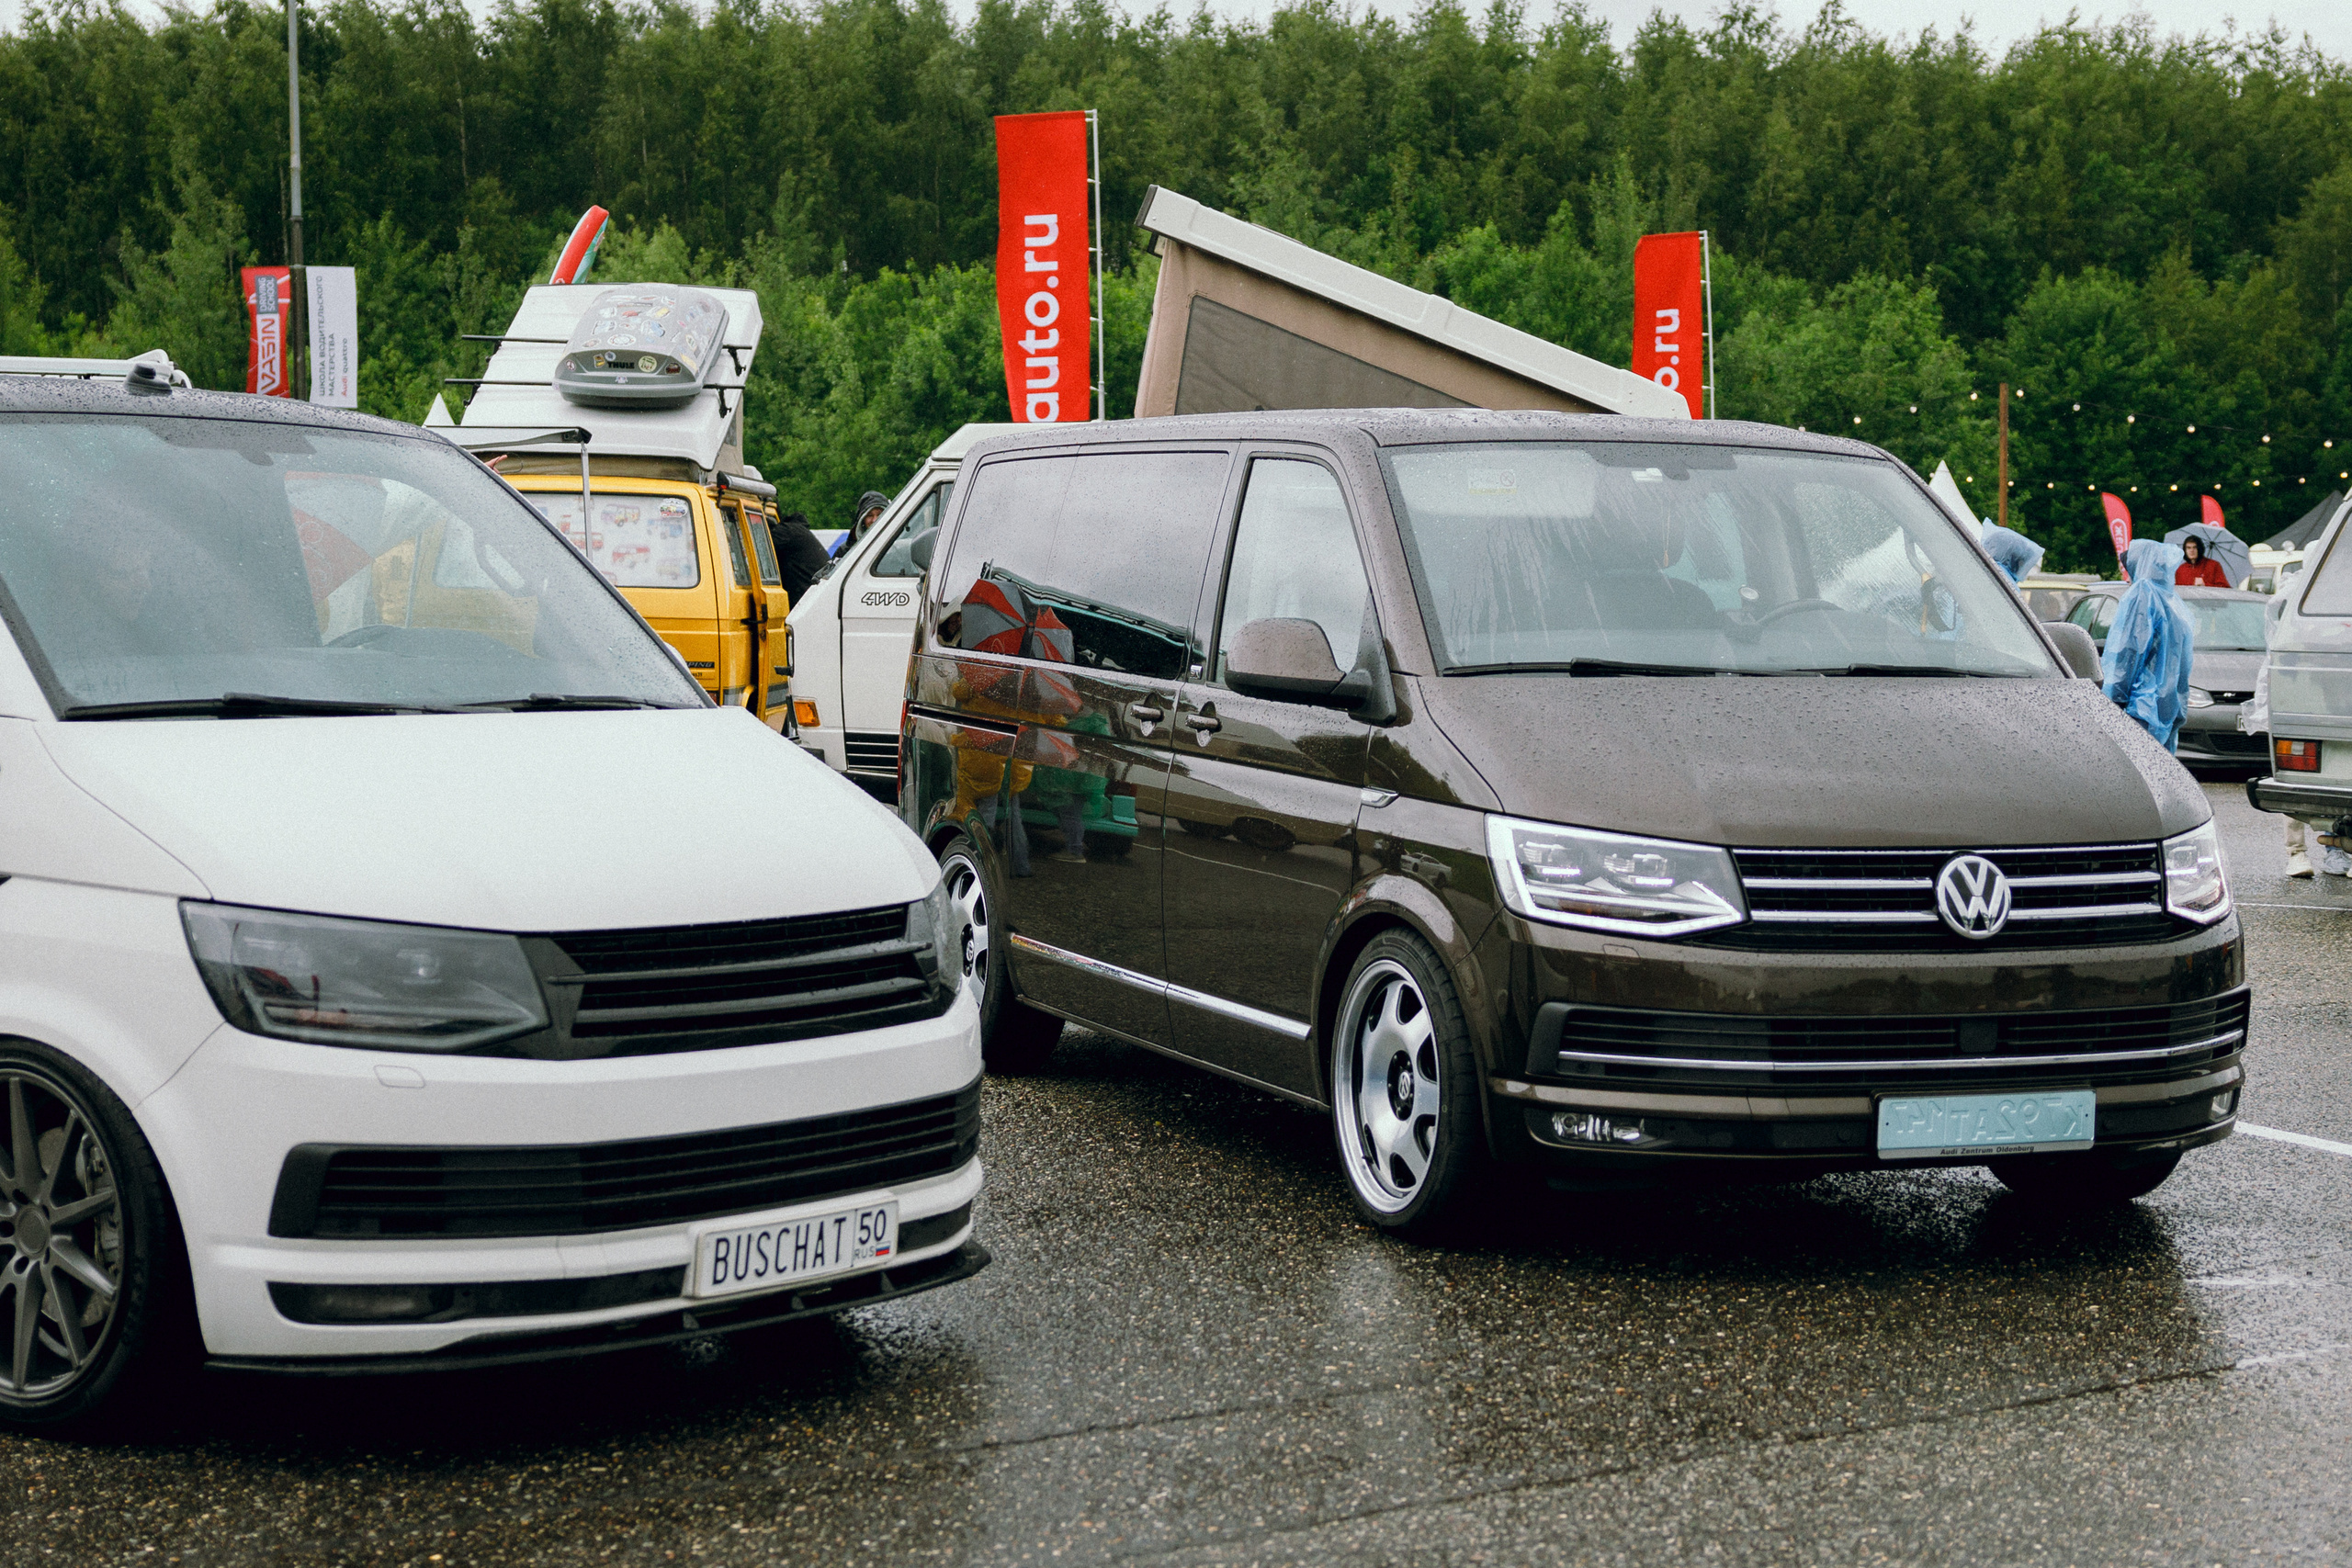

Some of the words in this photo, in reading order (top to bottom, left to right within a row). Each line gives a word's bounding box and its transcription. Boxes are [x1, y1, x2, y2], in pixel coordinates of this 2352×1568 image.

[267, 277, 276, 311] SCHOOL
[316, 276, 326, 358] ВОДИТЕЛЬСКОГО
[1018, 214, 1059, 423] auto.ru
[341, 338, 349, 374] quattro
[607, 361, 635, 369] THULE
[1654, 309, 1680, 391] o.ru
[861, 592, 910, 606] 4WD
[1996, 1145, 2035, 1153] Oldenburg
[712, 1217, 847, 1286] BUSCHAT
[858, 1209, 887, 1246] 50
[854, 1245, 876, 1260] RUS
